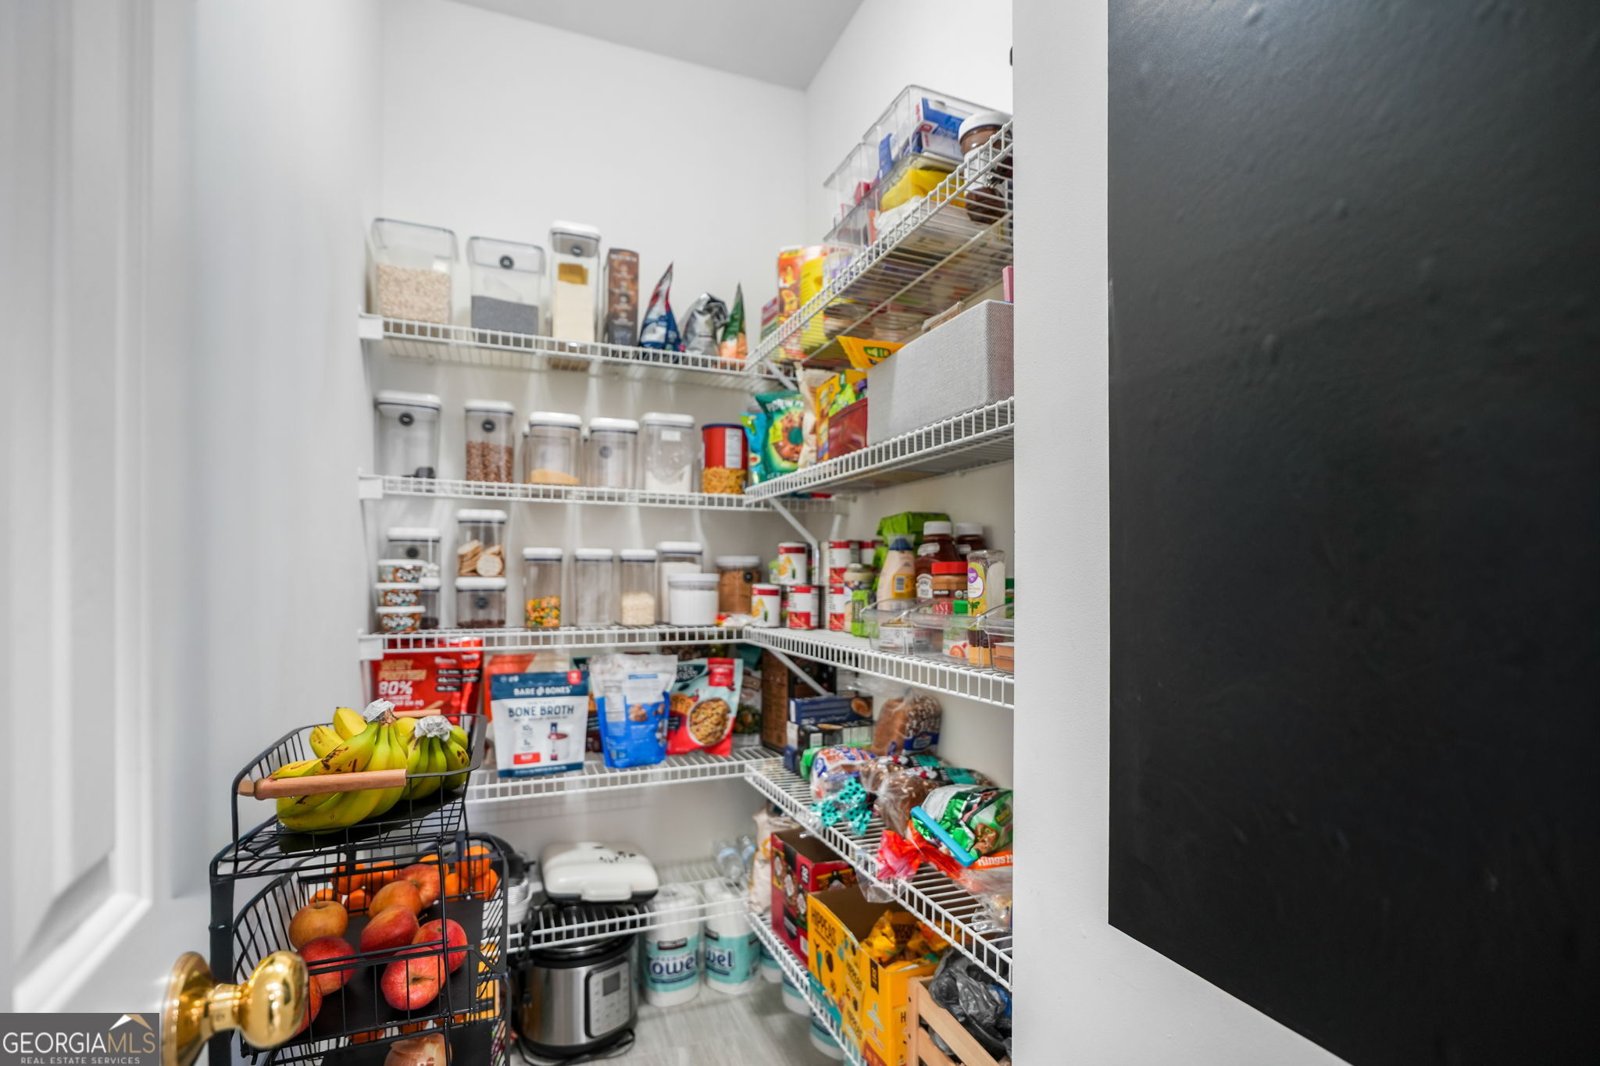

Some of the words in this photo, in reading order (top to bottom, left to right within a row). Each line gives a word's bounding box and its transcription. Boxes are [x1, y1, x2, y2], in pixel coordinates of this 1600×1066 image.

[513, 688, 535, 696] BARE
[545, 686, 571, 695] BONES
[508, 707, 537, 718] BONE
[540, 705, 575, 716] BROTH
